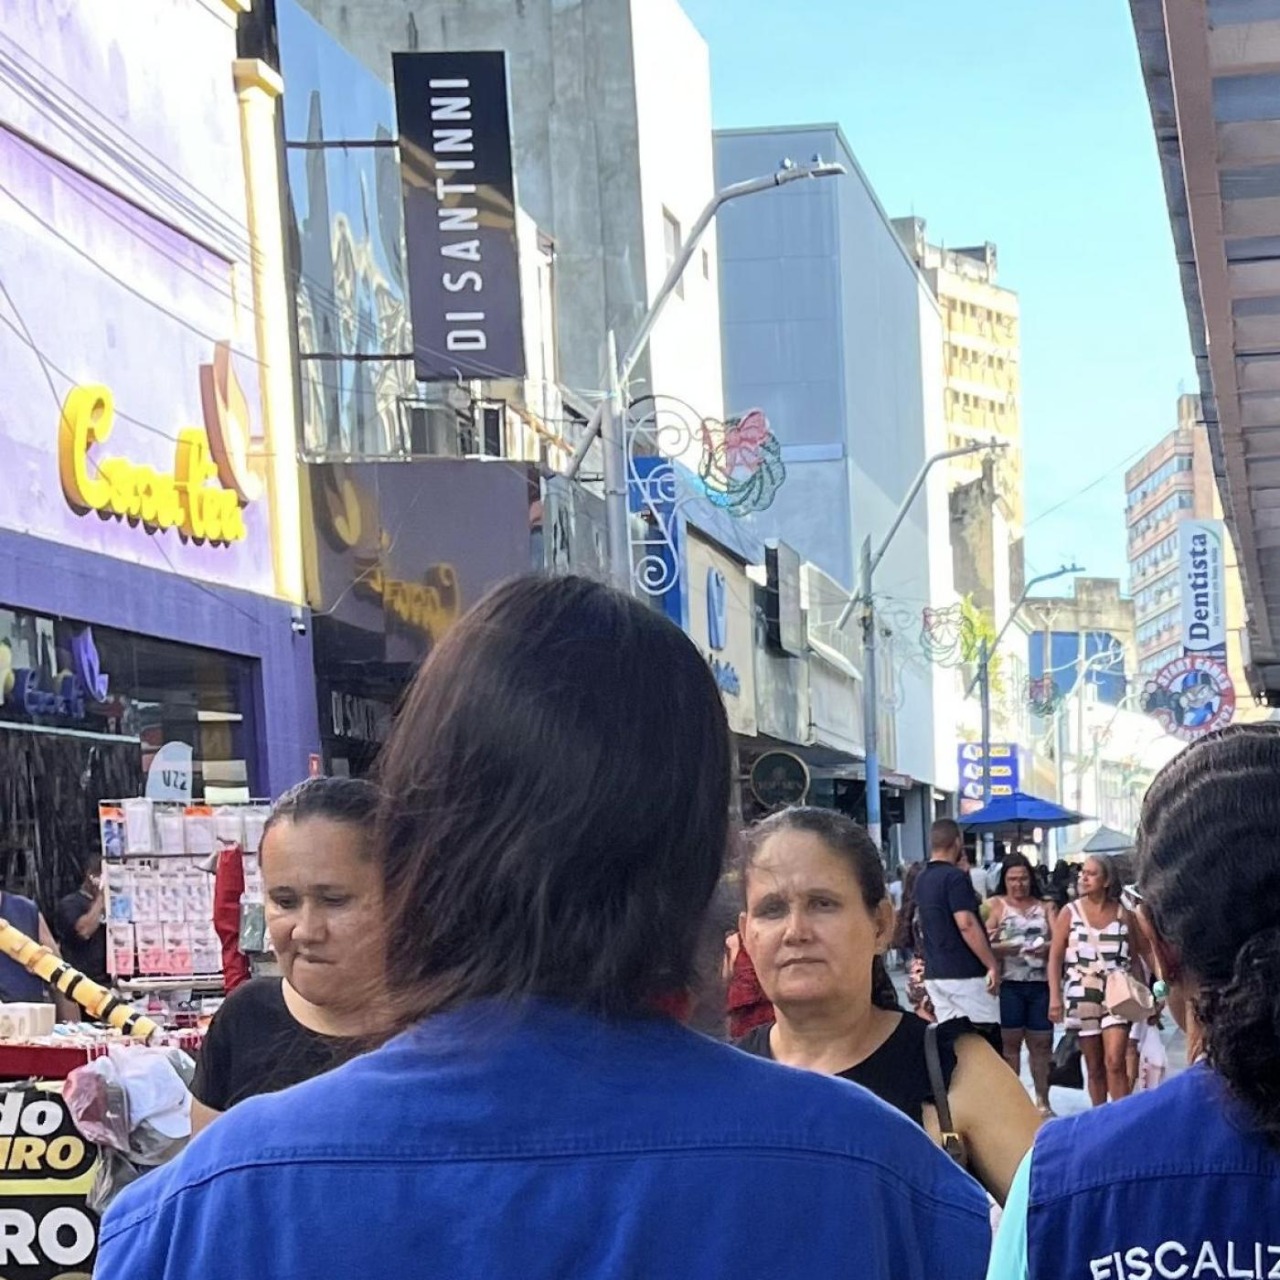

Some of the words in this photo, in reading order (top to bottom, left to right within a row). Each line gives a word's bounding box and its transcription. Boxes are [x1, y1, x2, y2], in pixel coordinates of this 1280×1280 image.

[429, 78, 483, 292] SANTINNI
[445, 311, 488, 351] DI
[1188, 533, 1210, 641] Dentista
[0, 1207, 95, 1266] RO
